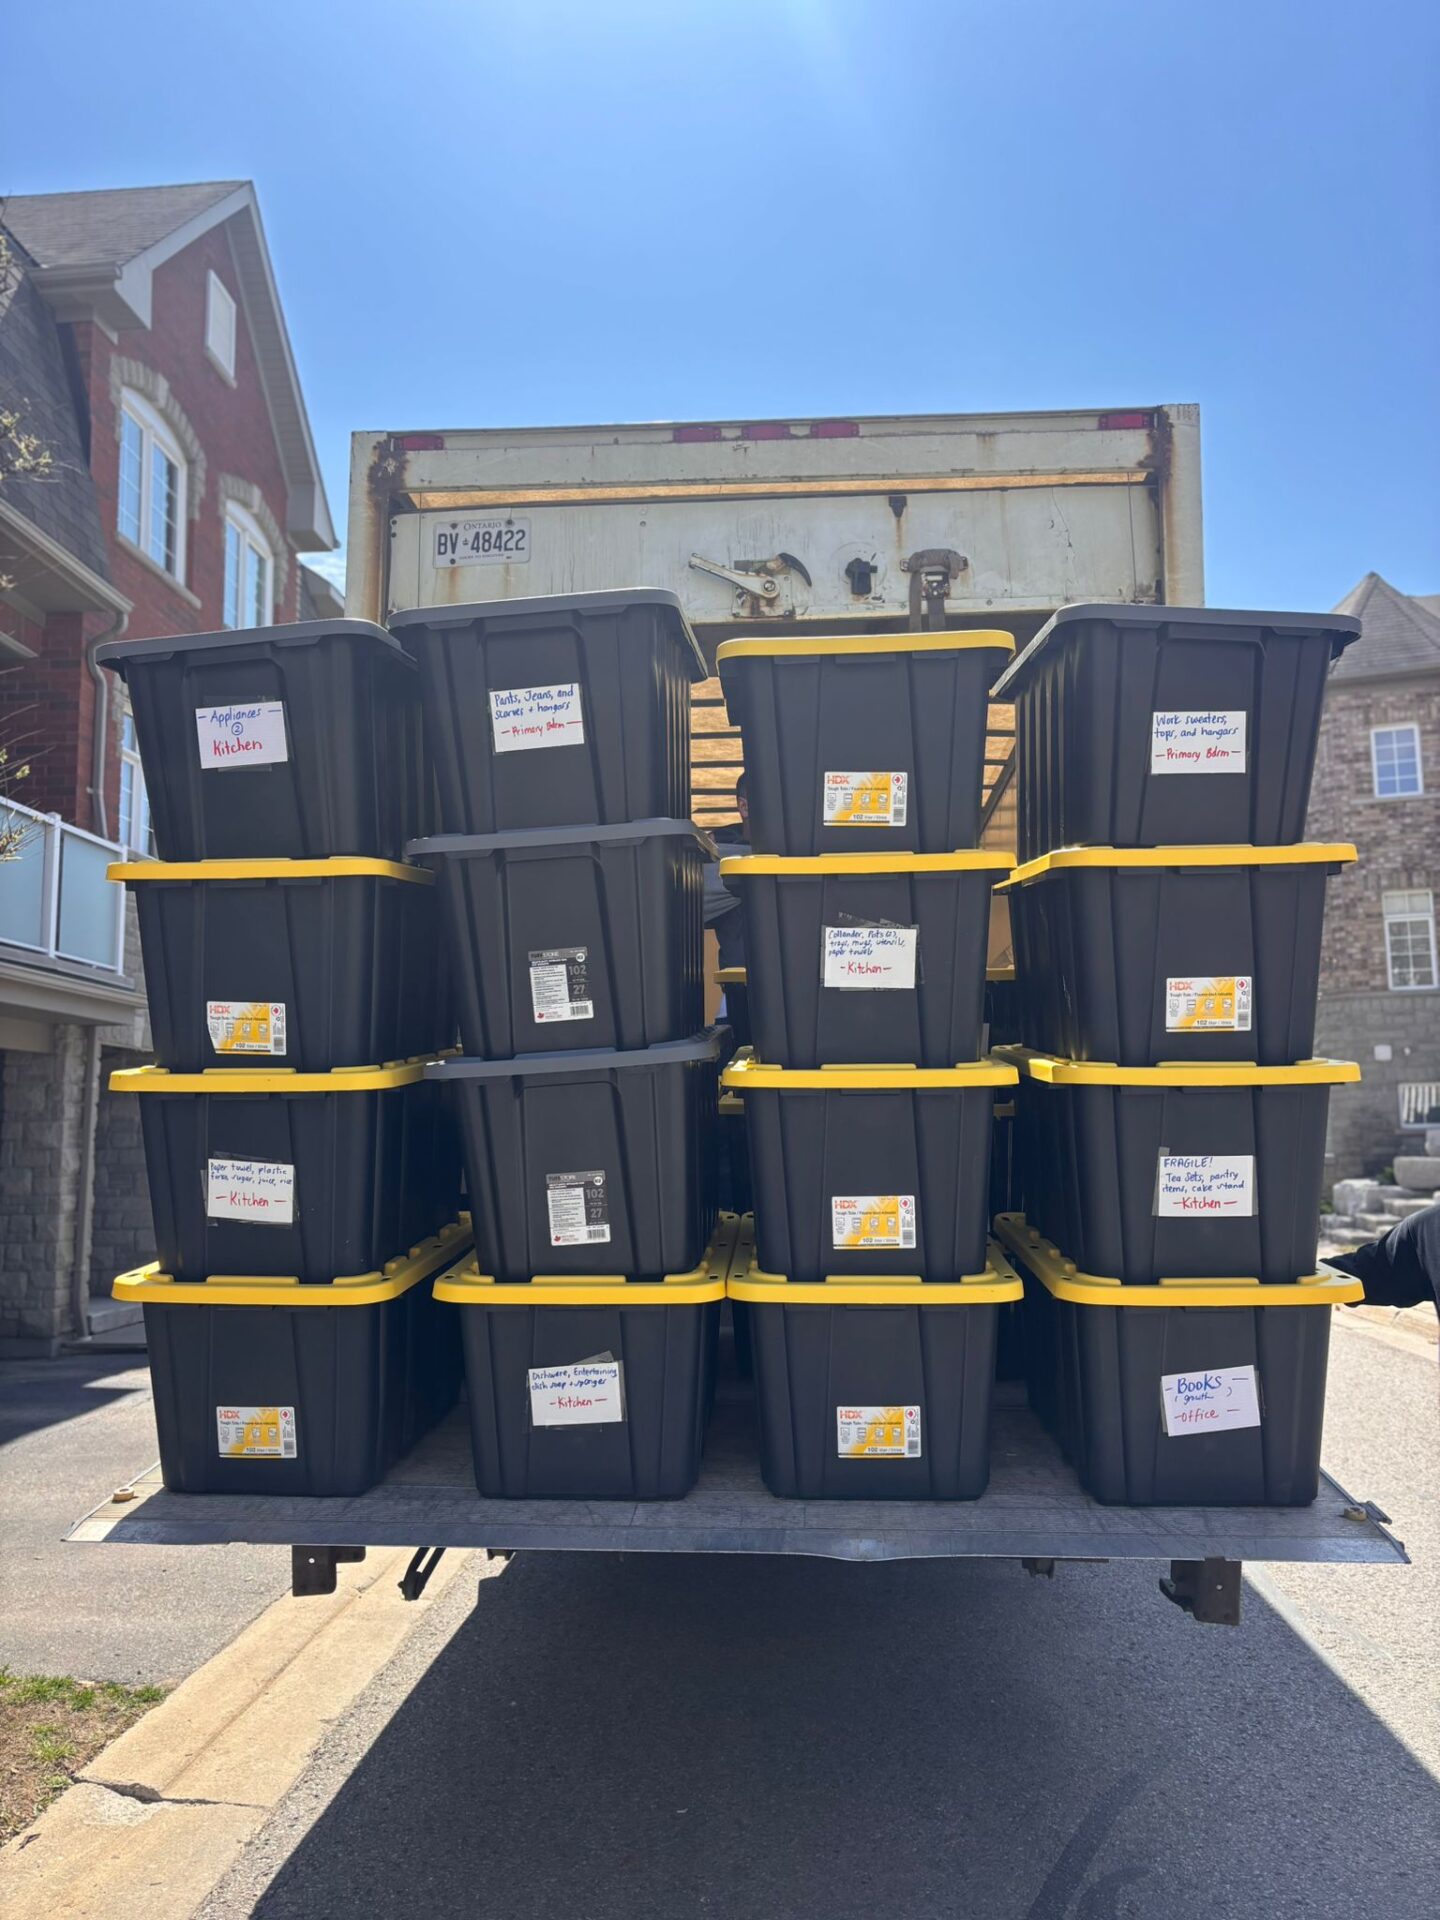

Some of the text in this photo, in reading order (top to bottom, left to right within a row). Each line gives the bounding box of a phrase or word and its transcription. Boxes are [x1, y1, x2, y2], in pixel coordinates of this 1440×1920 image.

[437, 529, 526, 555] BV 48422
[494, 684, 573, 707] Pants, Jeans, and
[210, 707, 261, 728] Appliances
[1156, 713, 1227, 726] Work sweaters,
[512, 726, 543, 737] Primary
[1154, 728, 1177, 741] tops,
[1180, 728, 1196, 737] and
[213, 737, 263, 757] Kitchen
[1167, 746, 1229, 762] Primary Bdrm
[827, 775, 849, 785] HDX
[568, 964, 587, 975] 102
[1169, 981, 1192, 991] HDX
[210, 1005, 230, 1014] HDX
[1164, 1157, 1213, 1168] FRAGILE!
[258, 1164, 287, 1175] plastic
[1165, 1172, 1181, 1182] Tea
[1210, 1169, 1239, 1181] pantry
[1192, 1184, 1212, 1192] cake
[1217, 1180, 1244, 1190] stand
[230, 1190, 269, 1207] Kitchen
[586, 1188, 604, 1199] 102
[834, 1199, 857, 1209] HDX
[531, 1382, 548, 1390] dish
[1177, 1373, 1222, 1394] Books
[219, 1410, 240, 1419] HDX
[840, 1410, 862, 1419] HDX
